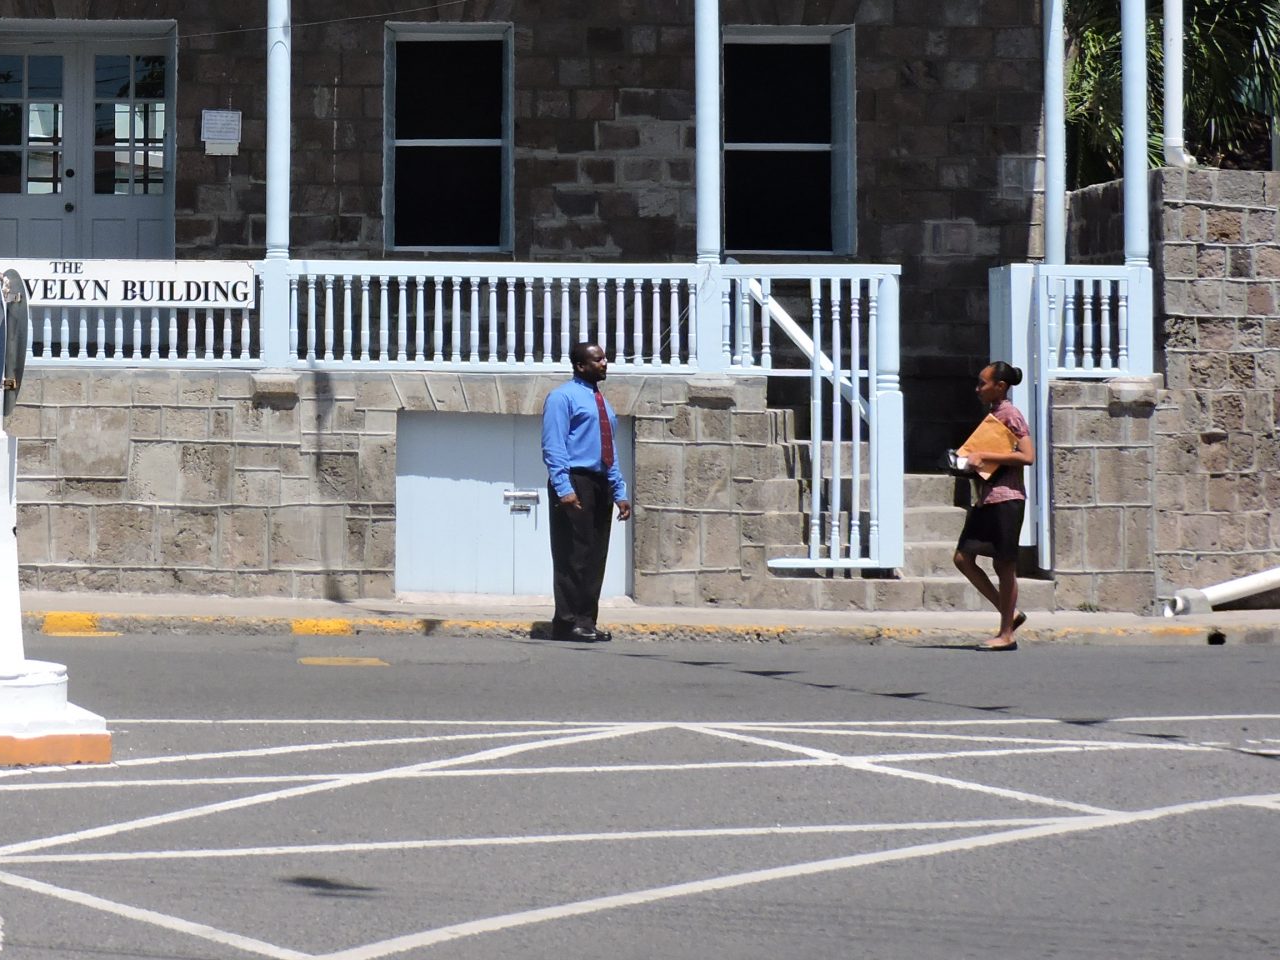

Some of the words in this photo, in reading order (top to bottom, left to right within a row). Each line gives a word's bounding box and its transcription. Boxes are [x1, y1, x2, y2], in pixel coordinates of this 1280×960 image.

[50, 261, 84, 275] THE
[23, 278, 110, 301] VELYN
[121, 280, 251, 303] BUILDING
